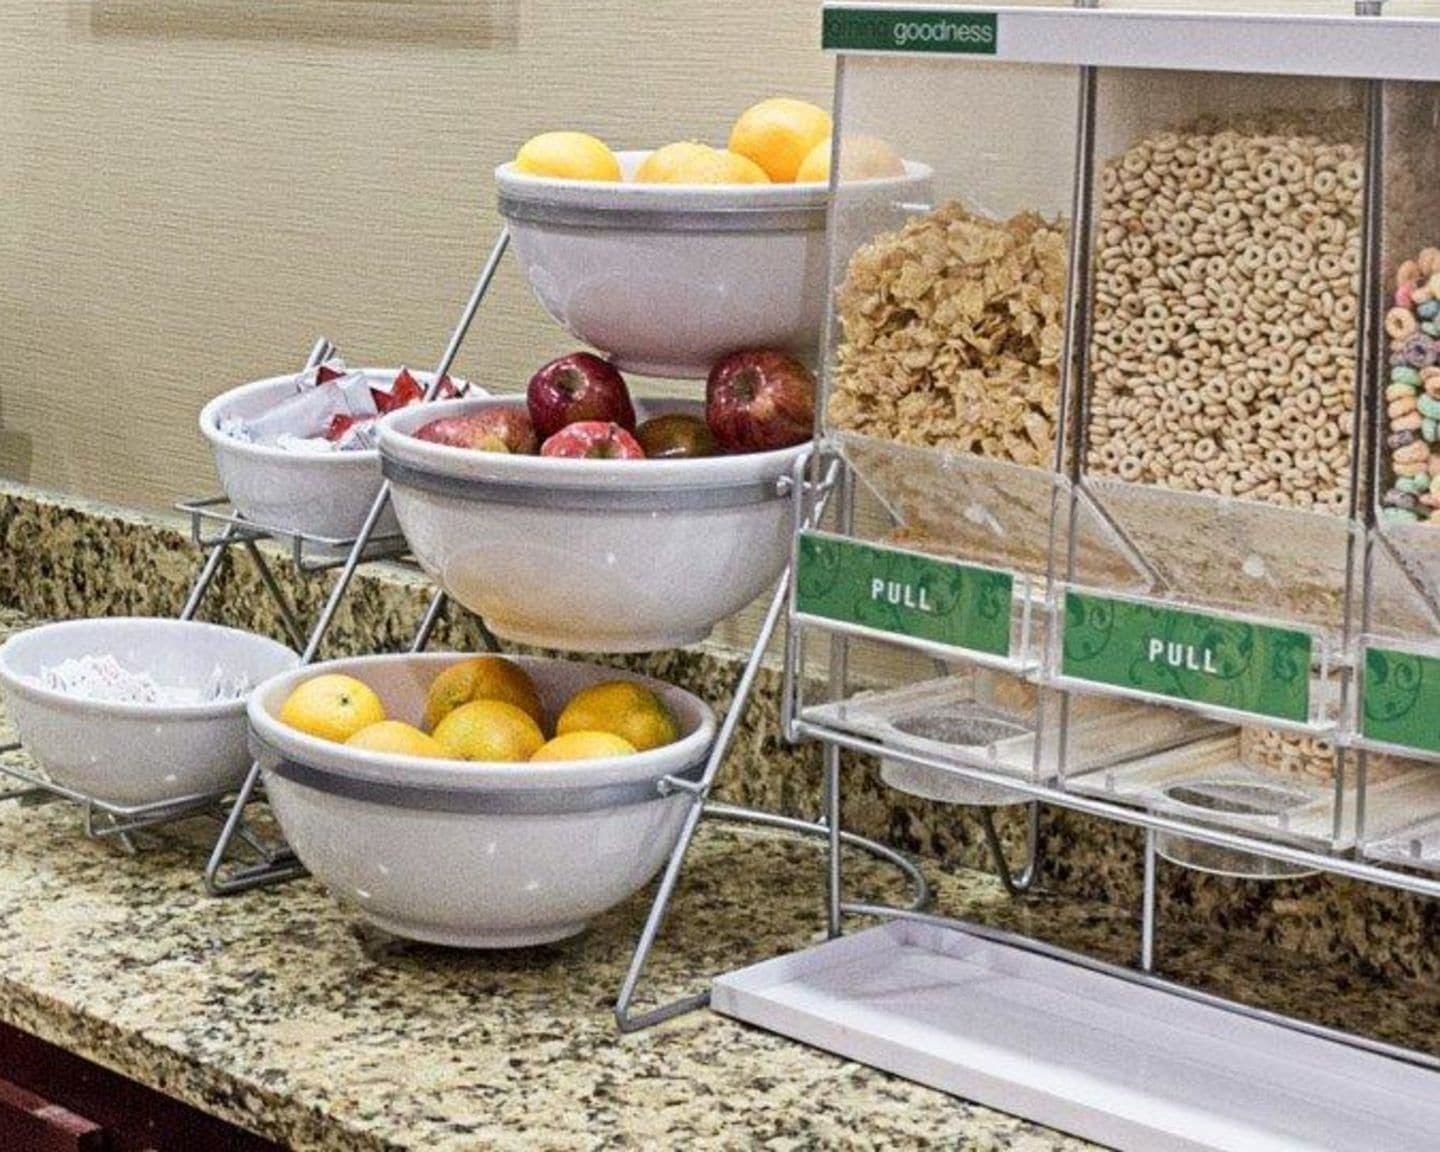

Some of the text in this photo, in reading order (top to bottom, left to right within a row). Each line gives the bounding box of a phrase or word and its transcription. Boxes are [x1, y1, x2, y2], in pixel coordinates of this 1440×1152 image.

[893, 19, 993, 45] goodness
[870, 578, 932, 613] PULL
[1148, 638, 1219, 675] PULL
